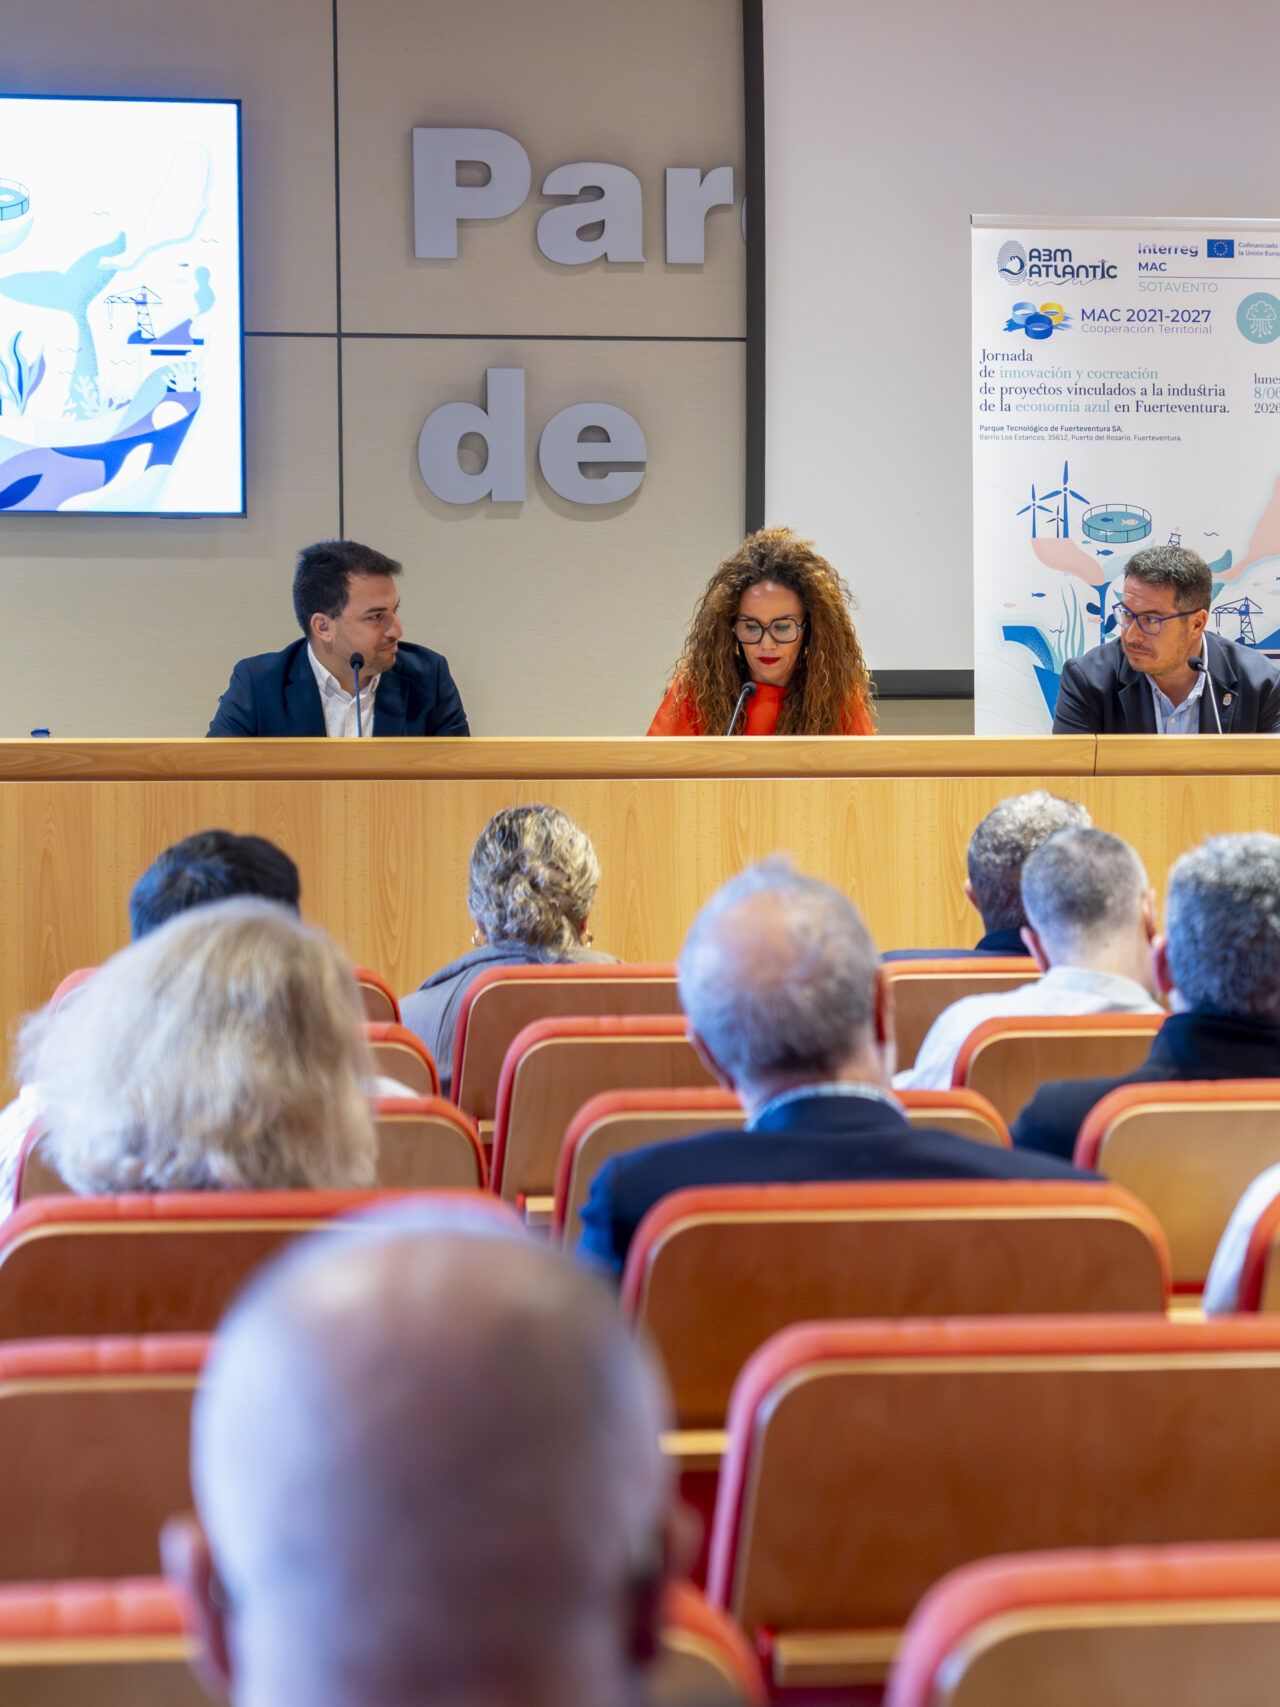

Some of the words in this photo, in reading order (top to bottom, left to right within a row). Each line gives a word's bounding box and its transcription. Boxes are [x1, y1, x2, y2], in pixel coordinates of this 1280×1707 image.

[412, 127, 746, 265] Par
[1138, 242, 1199, 258] Interreg
[1028, 259, 1118, 280] ATLANTIC
[1138, 262, 1167, 272] MAC
[1138, 281, 1219, 293] SOTAVENTO
[1081, 308, 1121, 323] MAC
[1126, 309, 1212, 324] 2021-2027
[1081, 323, 1155, 336] Cooperación
[1159, 323, 1212, 335] Territorial
[979, 349, 1033, 364] Jornada
[979, 367, 996, 379] de
[999, 367, 1072, 380] innovación
[1076, 370, 1084, 383] y
[1087, 367, 1159, 380] cocreación
[979, 383, 996, 396] de
[1000, 383, 1063, 400] proyectos
[1067, 382, 1136, 397] vinculados
[1140, 387, 1148, 396] a
[1152, 385, 1163, 397] la
[1167, 384, 1226, 397] industria
[979, 400, 996, 413] de
[1000, 400, 1012, 413] la
[1015, 401, 1080, 413] economía
[1084, 401, 1110, 413] azul
[1114, 404, 1131, 413] en
[1135, 401, 1230, 414] Fuerteventura.
[418, 368, 647, 504] de
[979, 425, 1005, 433] Parque
[1006, 424, 1049, 433] Tecnológico
[1060, 425, 1111, 433] Fuerteventura
